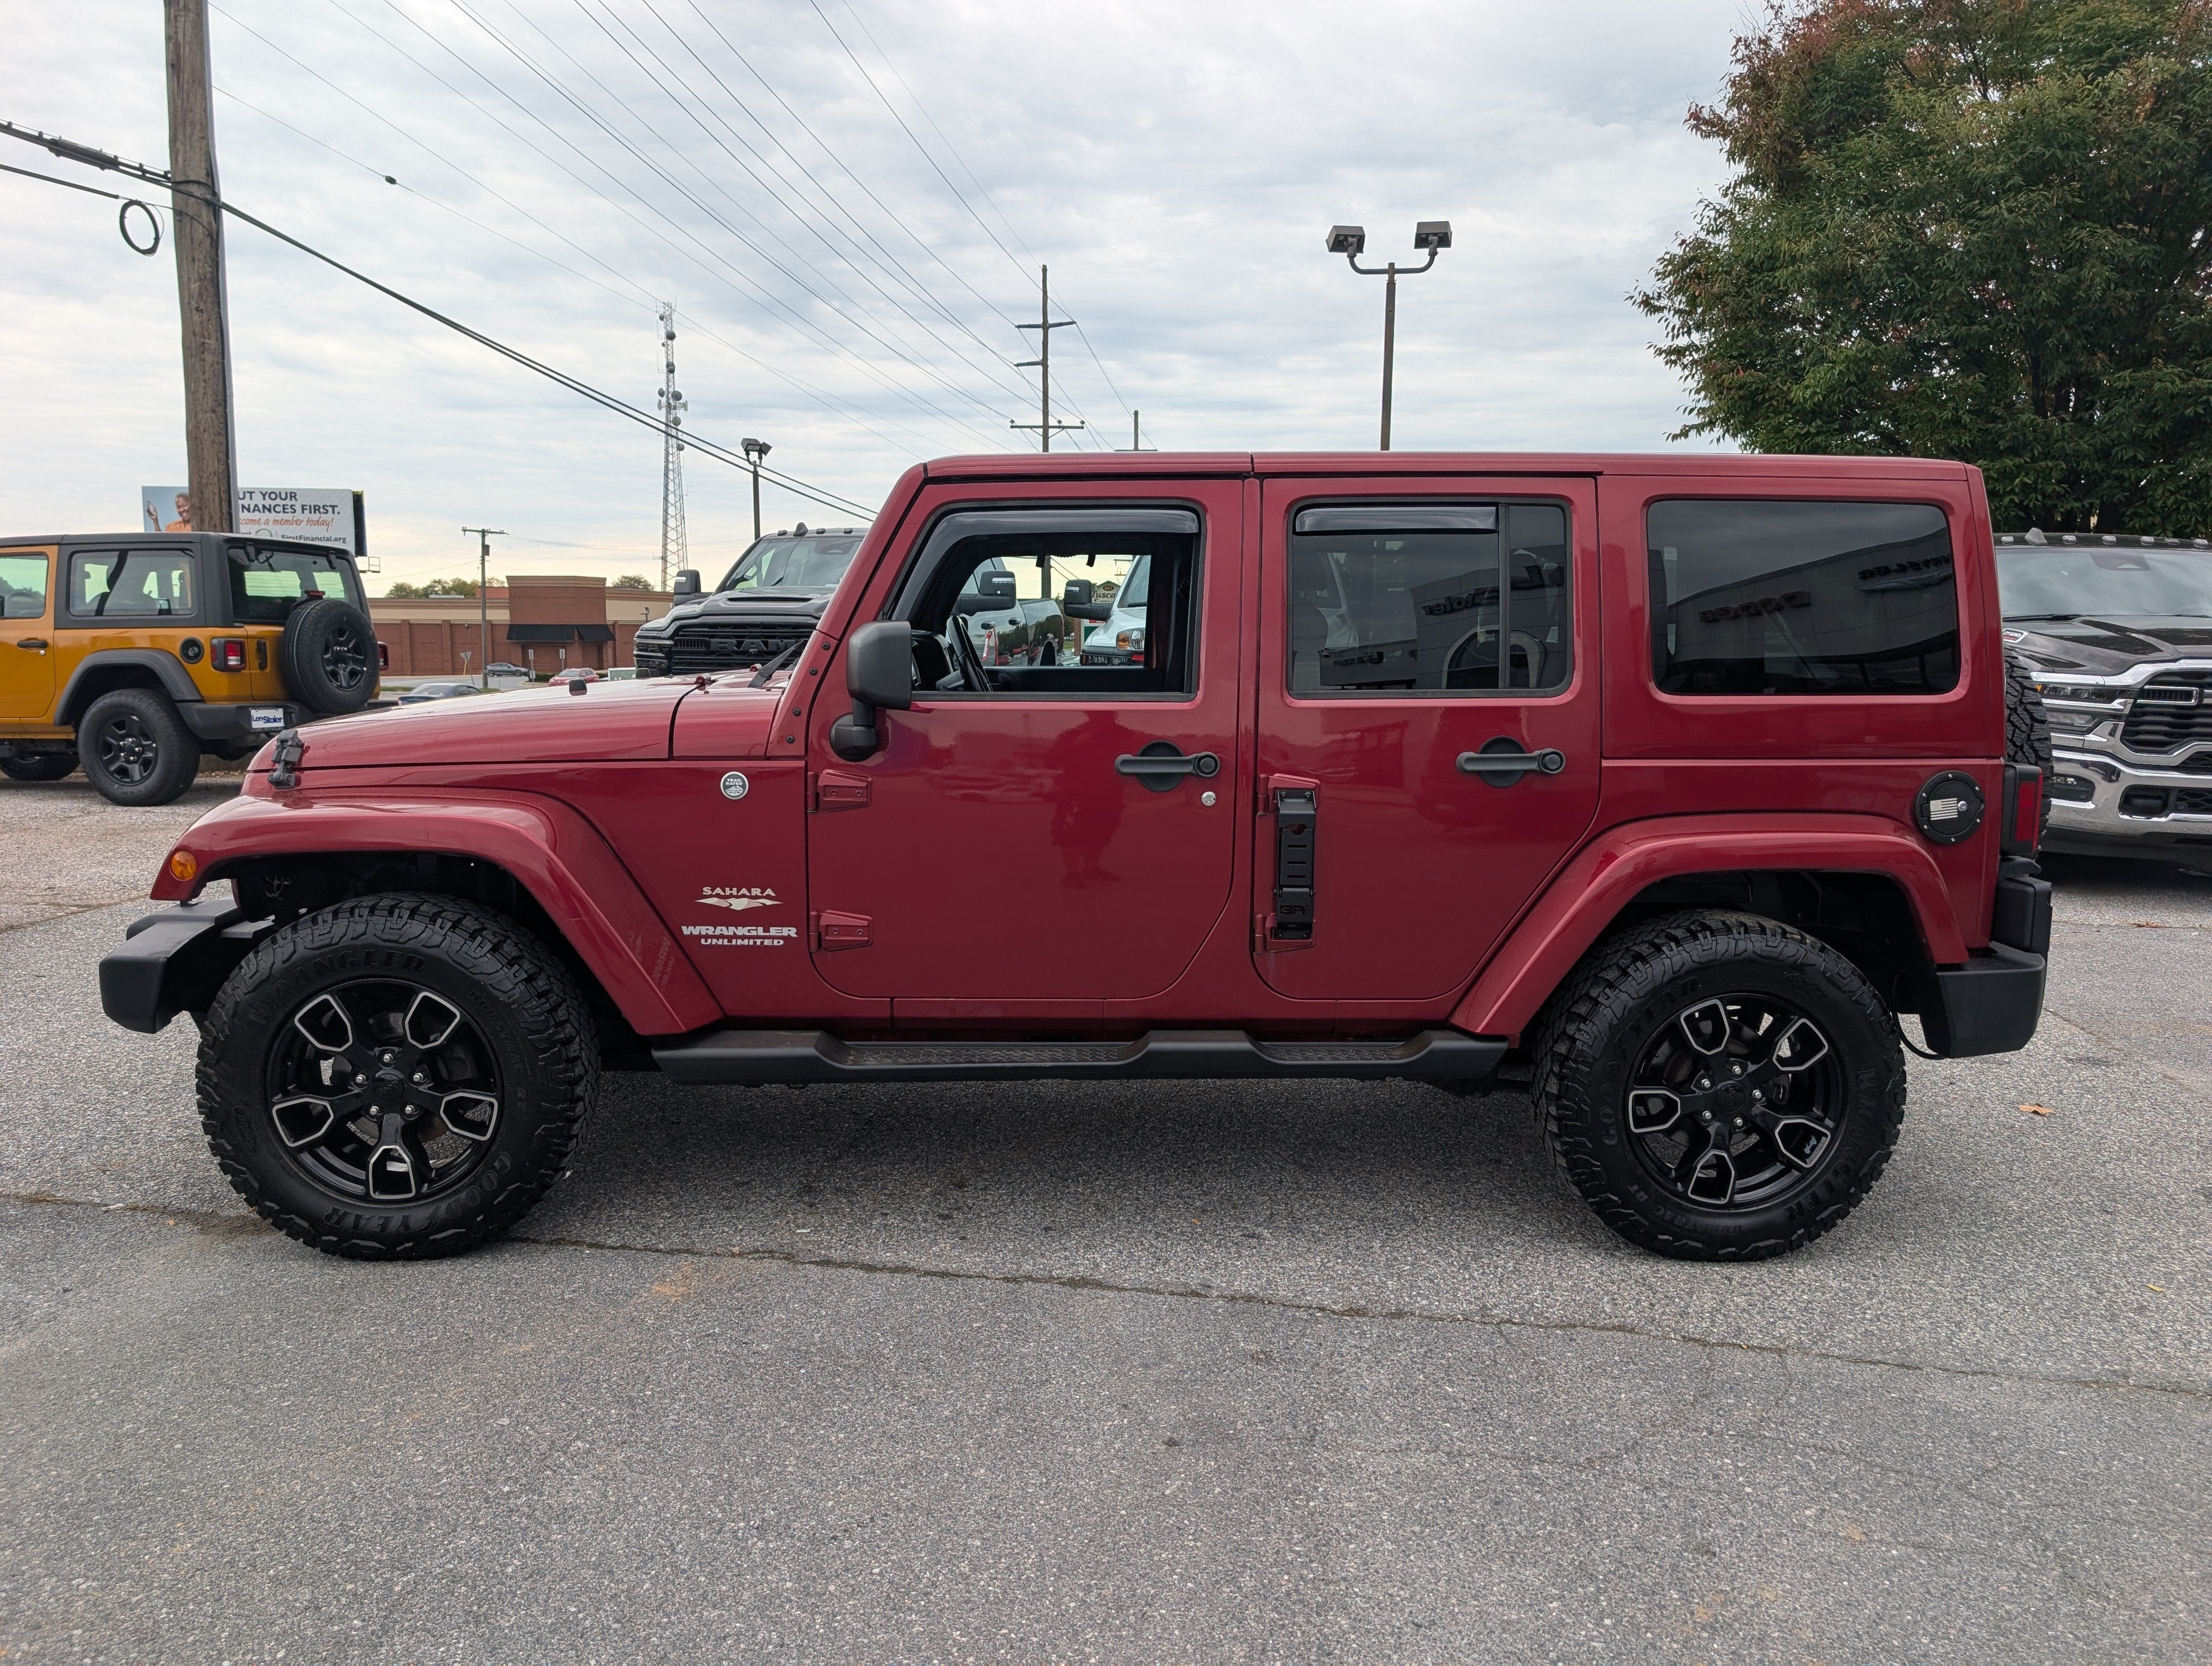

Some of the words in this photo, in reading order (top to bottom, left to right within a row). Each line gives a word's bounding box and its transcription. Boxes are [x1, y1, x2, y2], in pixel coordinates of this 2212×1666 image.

[239, 491, 255, 500] UT
[260, 491, 298, 501] YOUR
[241, 503, 297, 514] NANCES
[301, 504, 340, 515] FIRST.
[239, 517, 262, 526] come
[272, 515, 303, 526] member
[306, 515, 334, 532] today!
[281, 534, 347, 544] FirstFinancial.org
[710, 638, 796, 652] RAM
[702, 887, 776, 896] SAHARA
[681, 925, 799, 938] WRANGLER
[700, 938, 785, 946] UNLIMITED
